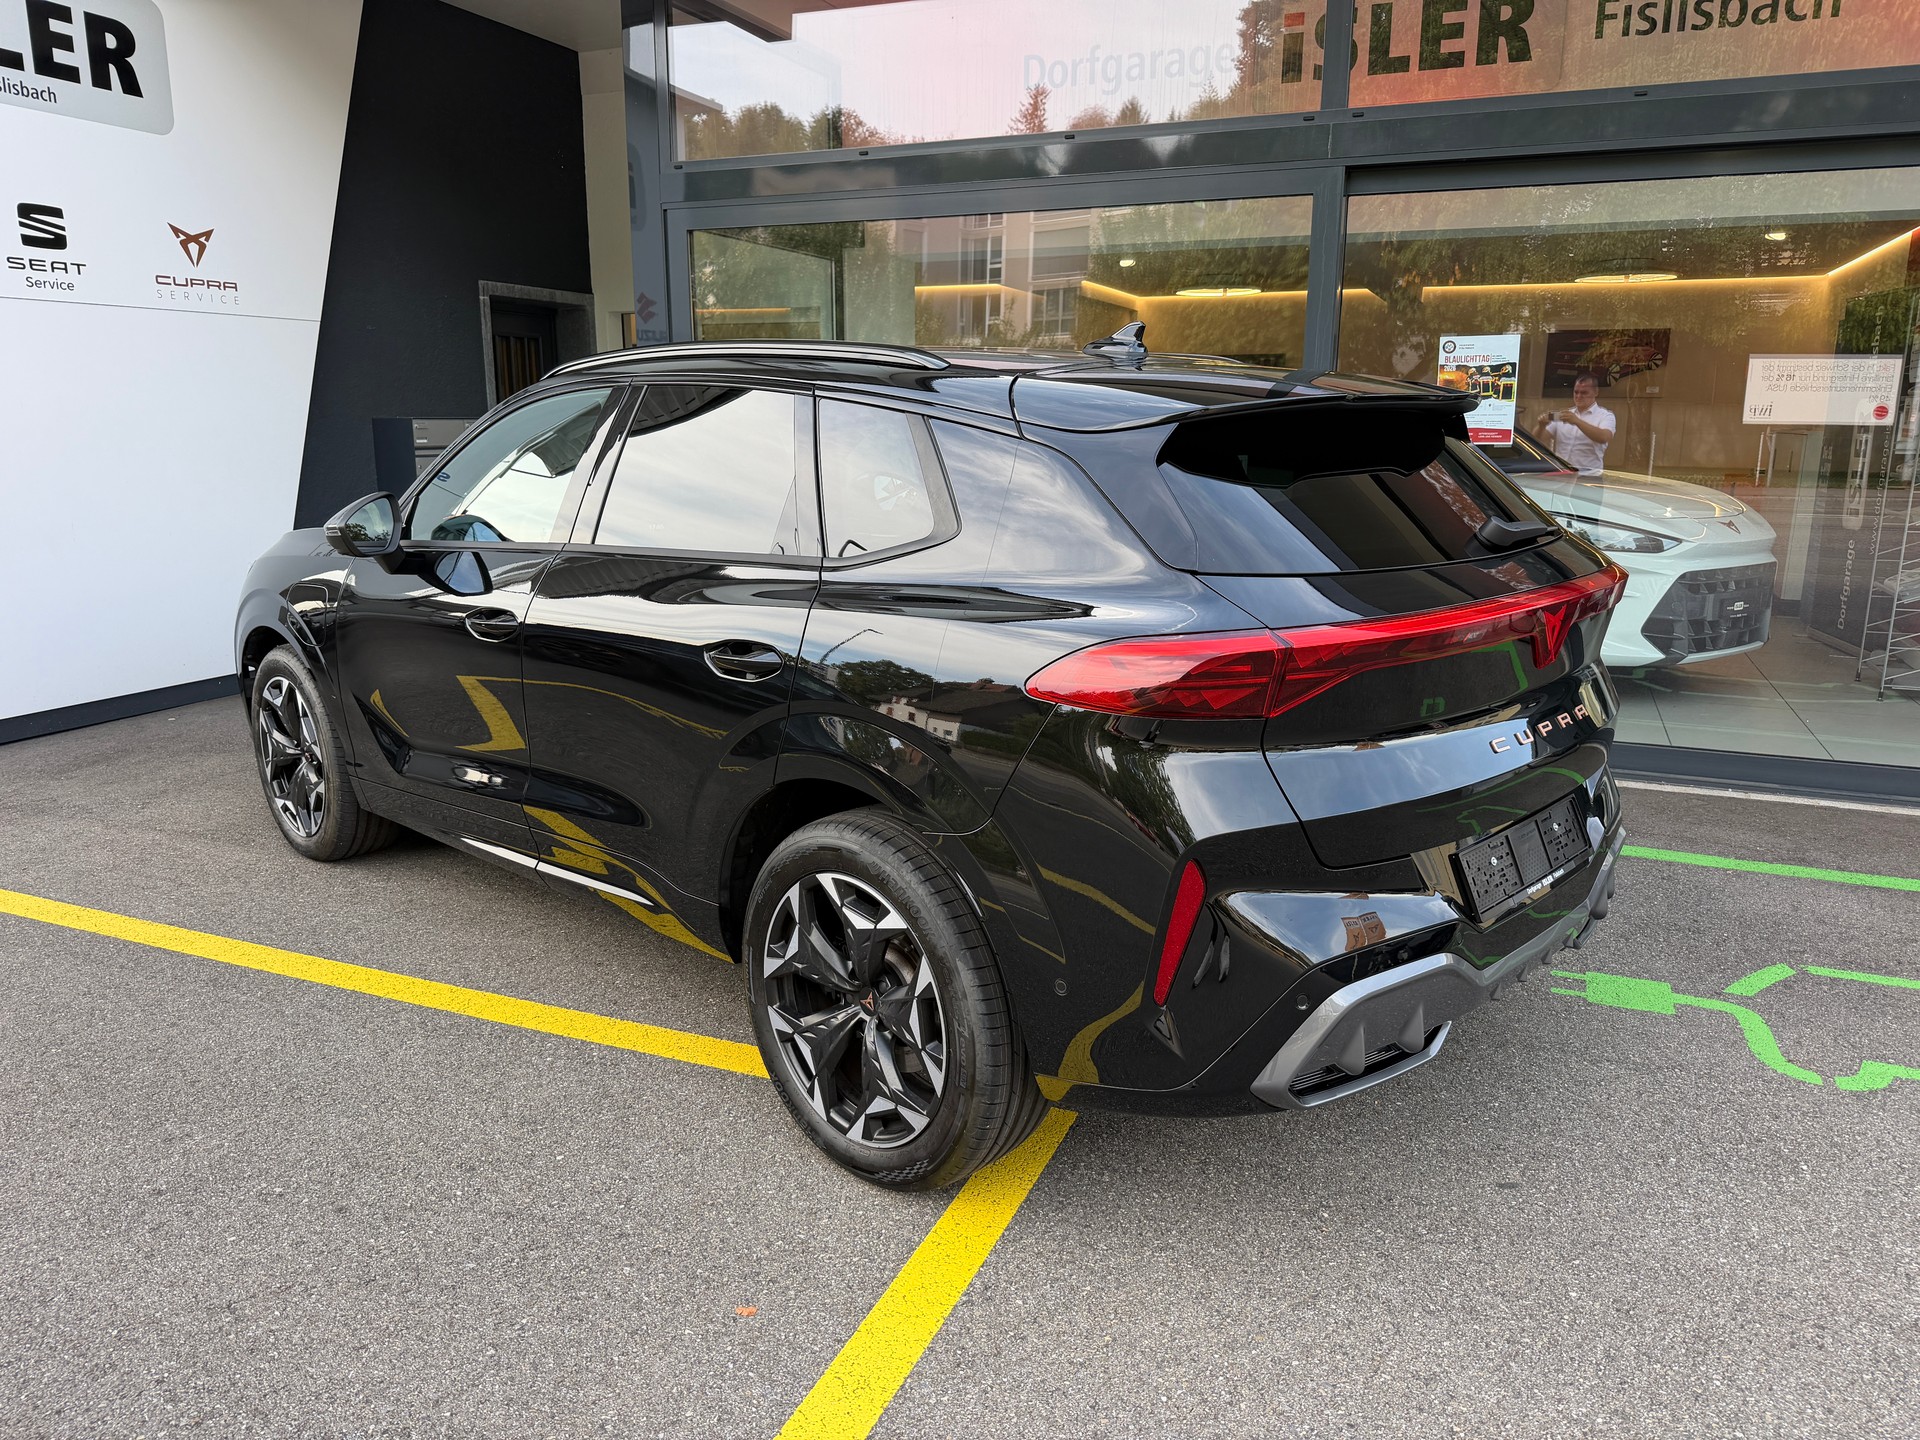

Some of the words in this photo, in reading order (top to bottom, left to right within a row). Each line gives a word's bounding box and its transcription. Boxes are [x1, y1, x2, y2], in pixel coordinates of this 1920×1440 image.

[1023, 44, 1234, 95] Dorfgarage
[6, 256, 87, 275] SEAT
[25, 276, 75, 291] Service
[155, 274, 238, 292] CUPRA
[156, 289, 240, 305] SERVICE
[1444, 354, 1490, 364] BLAULICHTTAG
[1837, 539, 1856, 630] Dorfgarage
[1489, 703, 1590, 754] CUPRA
